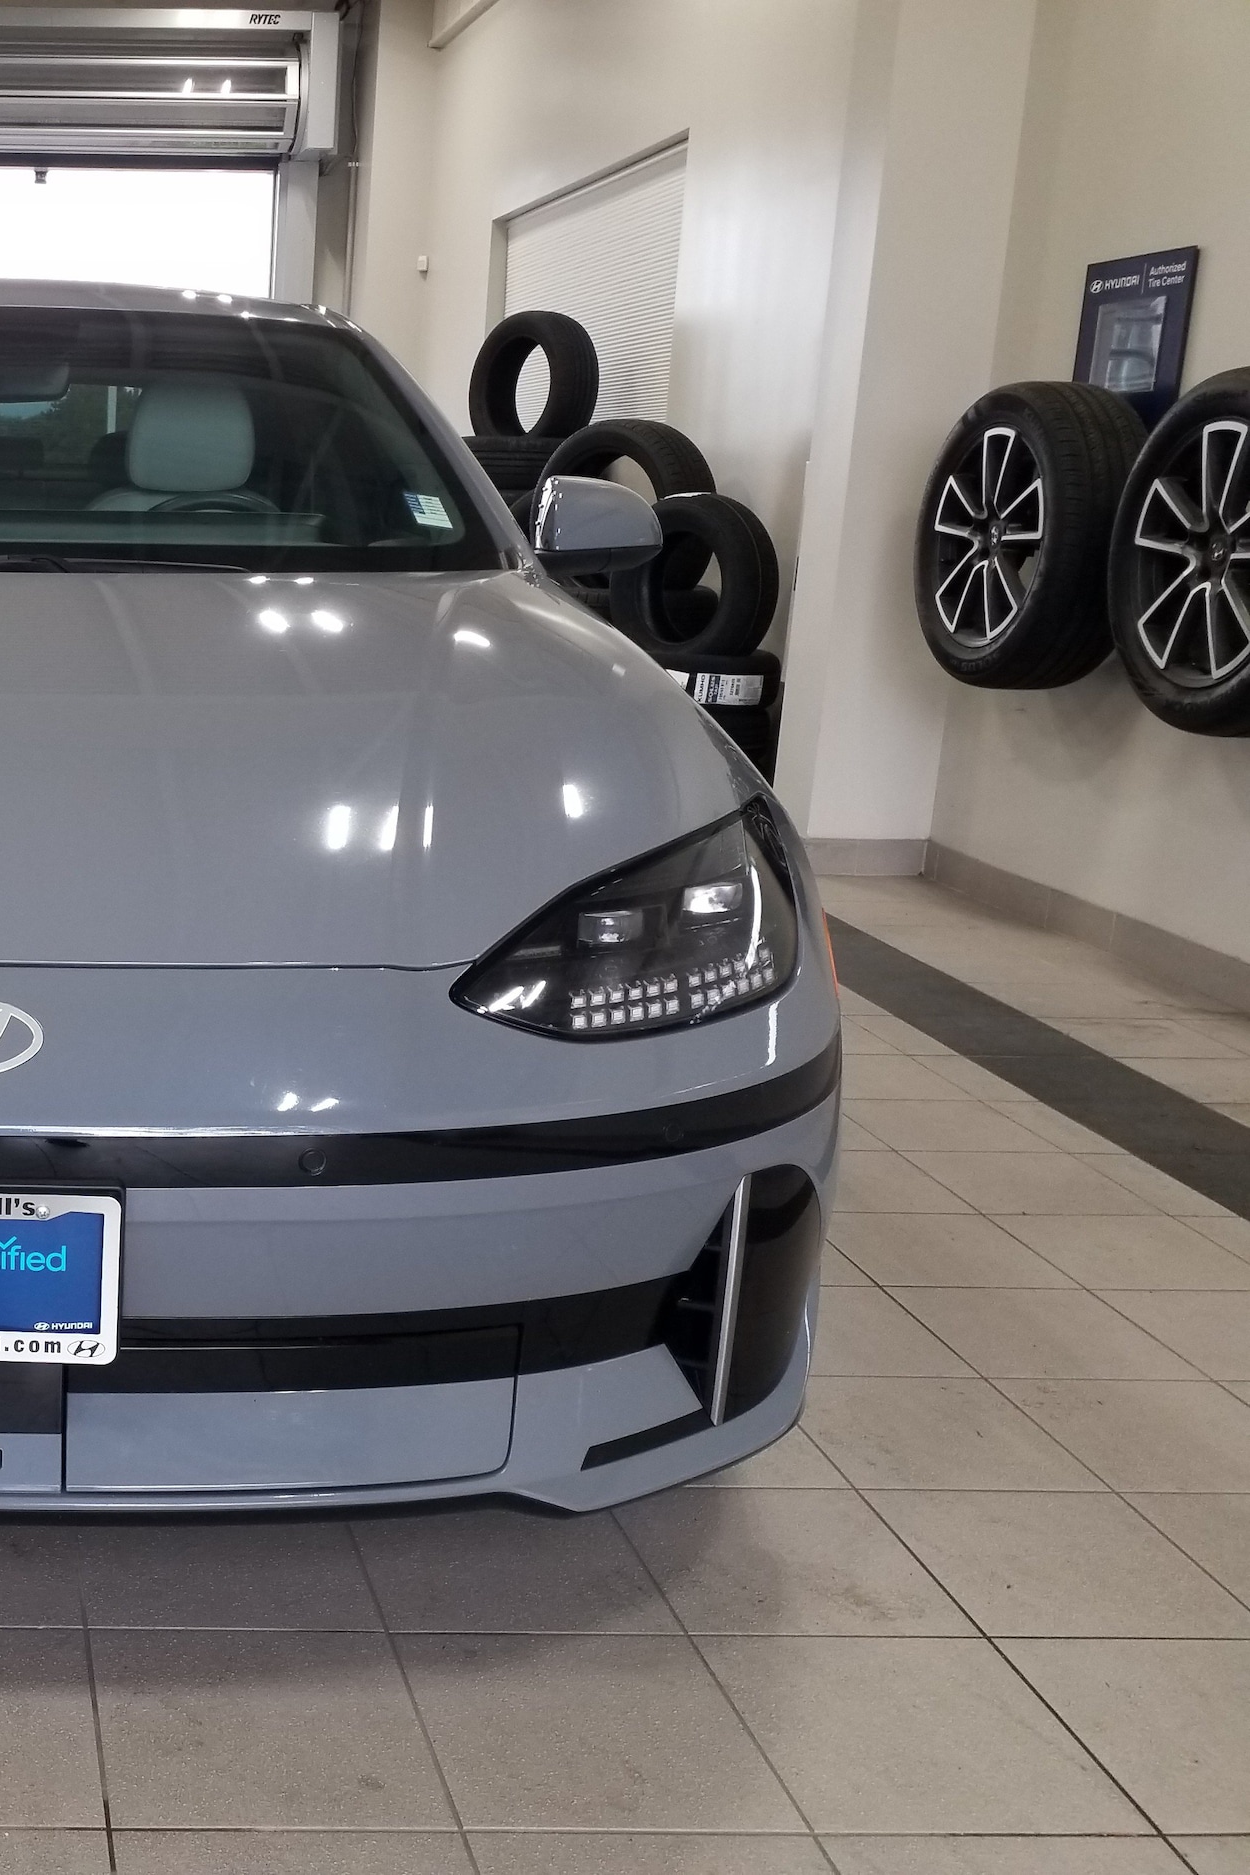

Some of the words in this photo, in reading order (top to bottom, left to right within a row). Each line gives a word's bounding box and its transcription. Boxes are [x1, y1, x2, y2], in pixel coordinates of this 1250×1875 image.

[249, 13, 281, 25] RYTEC
[1149, 260, 1188, 276] Authorized
[1104, 274, 1141, 290] HYUNDAI
[1148, 278, 1160, 288] Tire
[1161, 274, 1186, 287] Center
[697, 674, 706, 702] KUMHO
[51, 1321, 93, 1331] HYUNDAI
